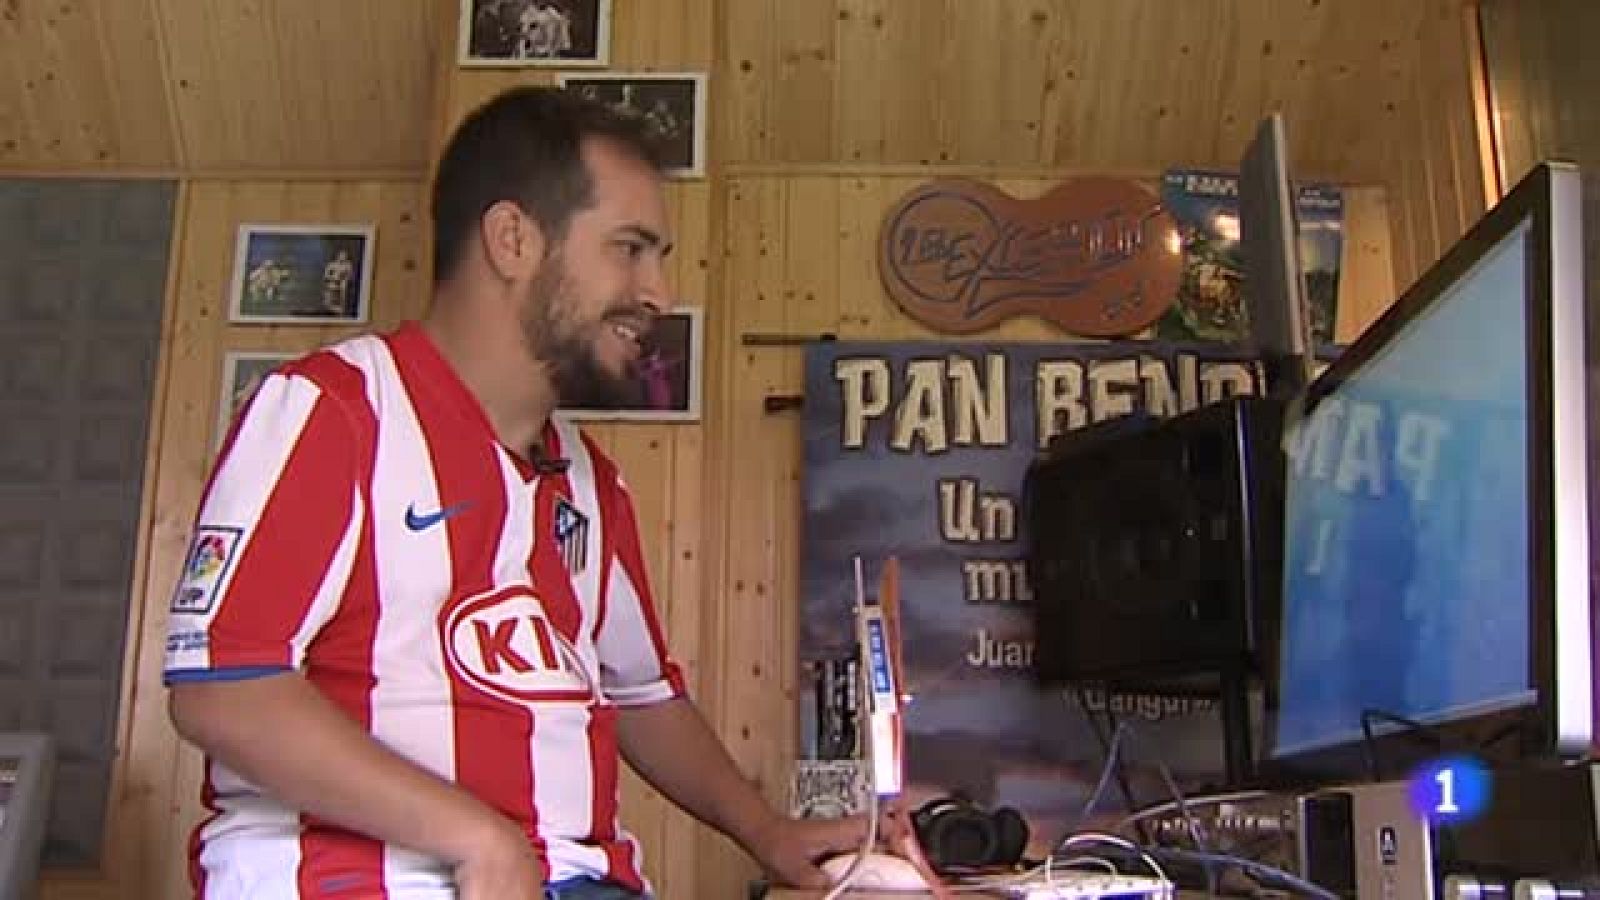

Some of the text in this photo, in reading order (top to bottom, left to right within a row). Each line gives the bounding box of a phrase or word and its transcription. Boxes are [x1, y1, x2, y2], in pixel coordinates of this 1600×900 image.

[836, 353, 1266, 453] PAN BEN
[939, 479, 1016, 541] Un
